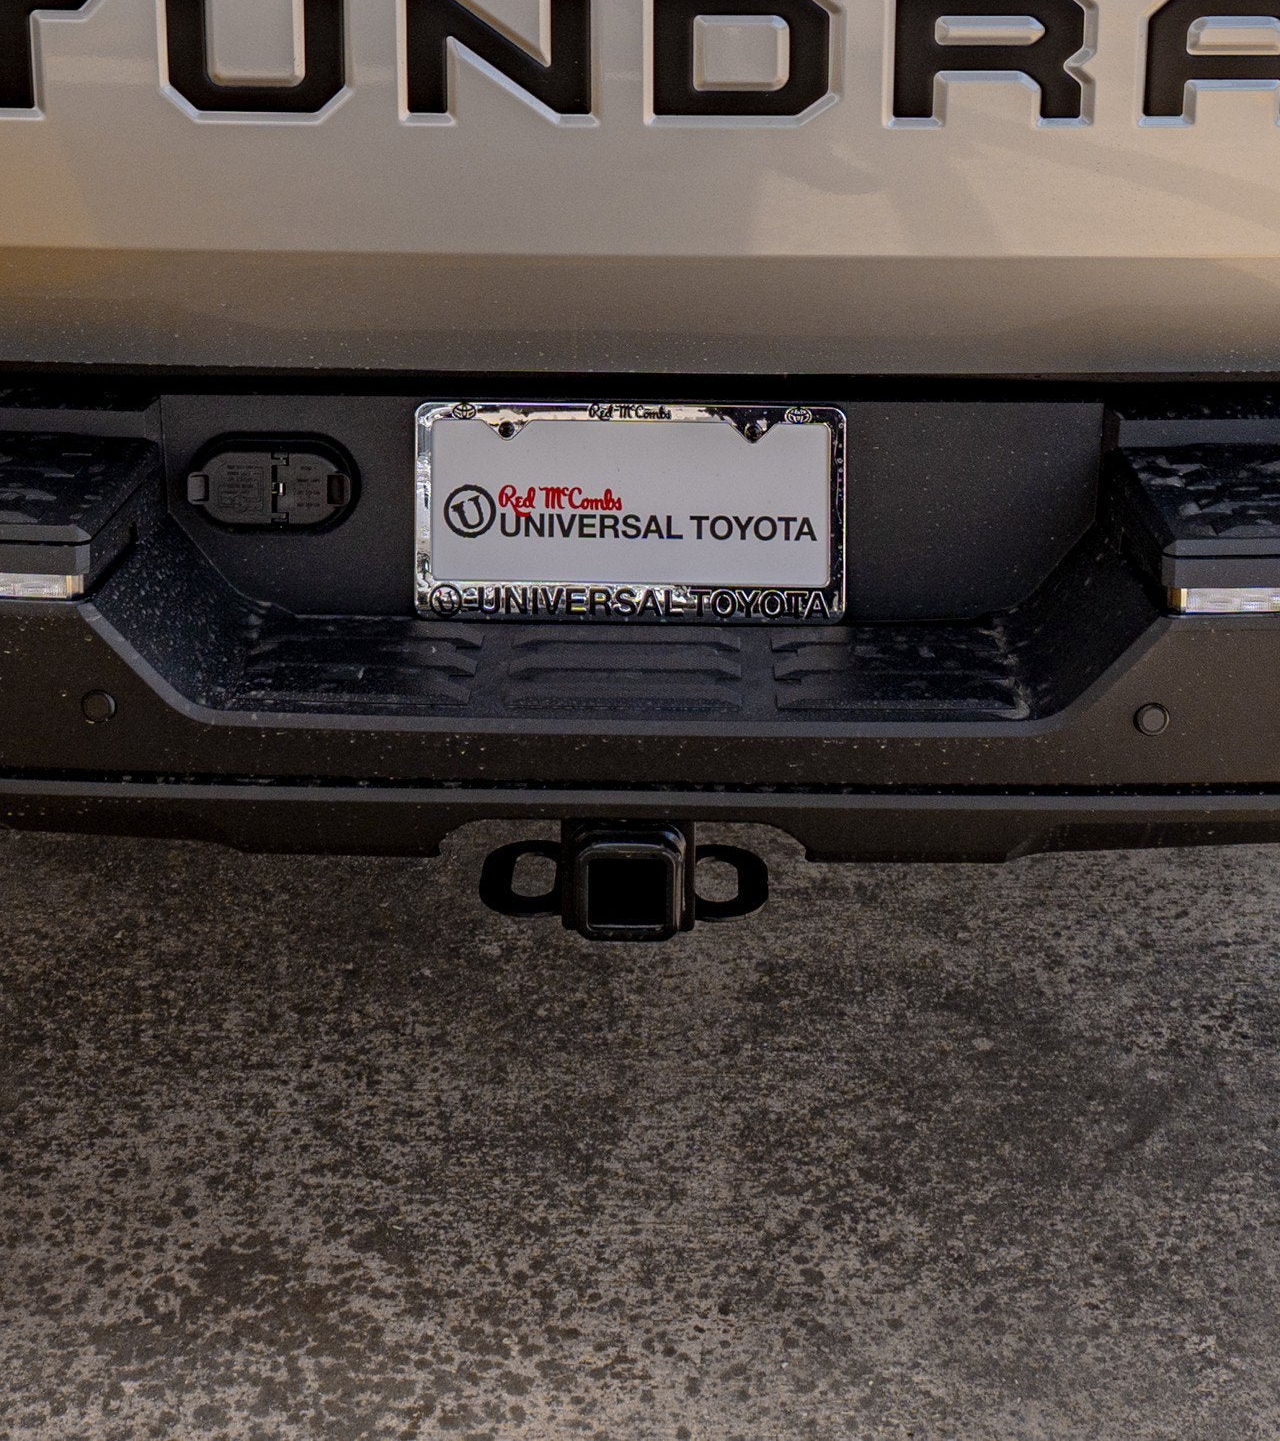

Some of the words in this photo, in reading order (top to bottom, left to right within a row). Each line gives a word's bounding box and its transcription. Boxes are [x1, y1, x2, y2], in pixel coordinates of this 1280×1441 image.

[588, 402, 613, 421] Red
[614, 404, 671, 420] McCombs
[498, 484, 536, 518] Red
[539, 485, 623, 511] McCombs
[499, 514, 684, 539] UNIVERSAL
[690, 515, 817, 542] TOYOTA
[477, 587, 685, 617] UNIVERSAL
[695, 589, 830, 619] TOYOTA
